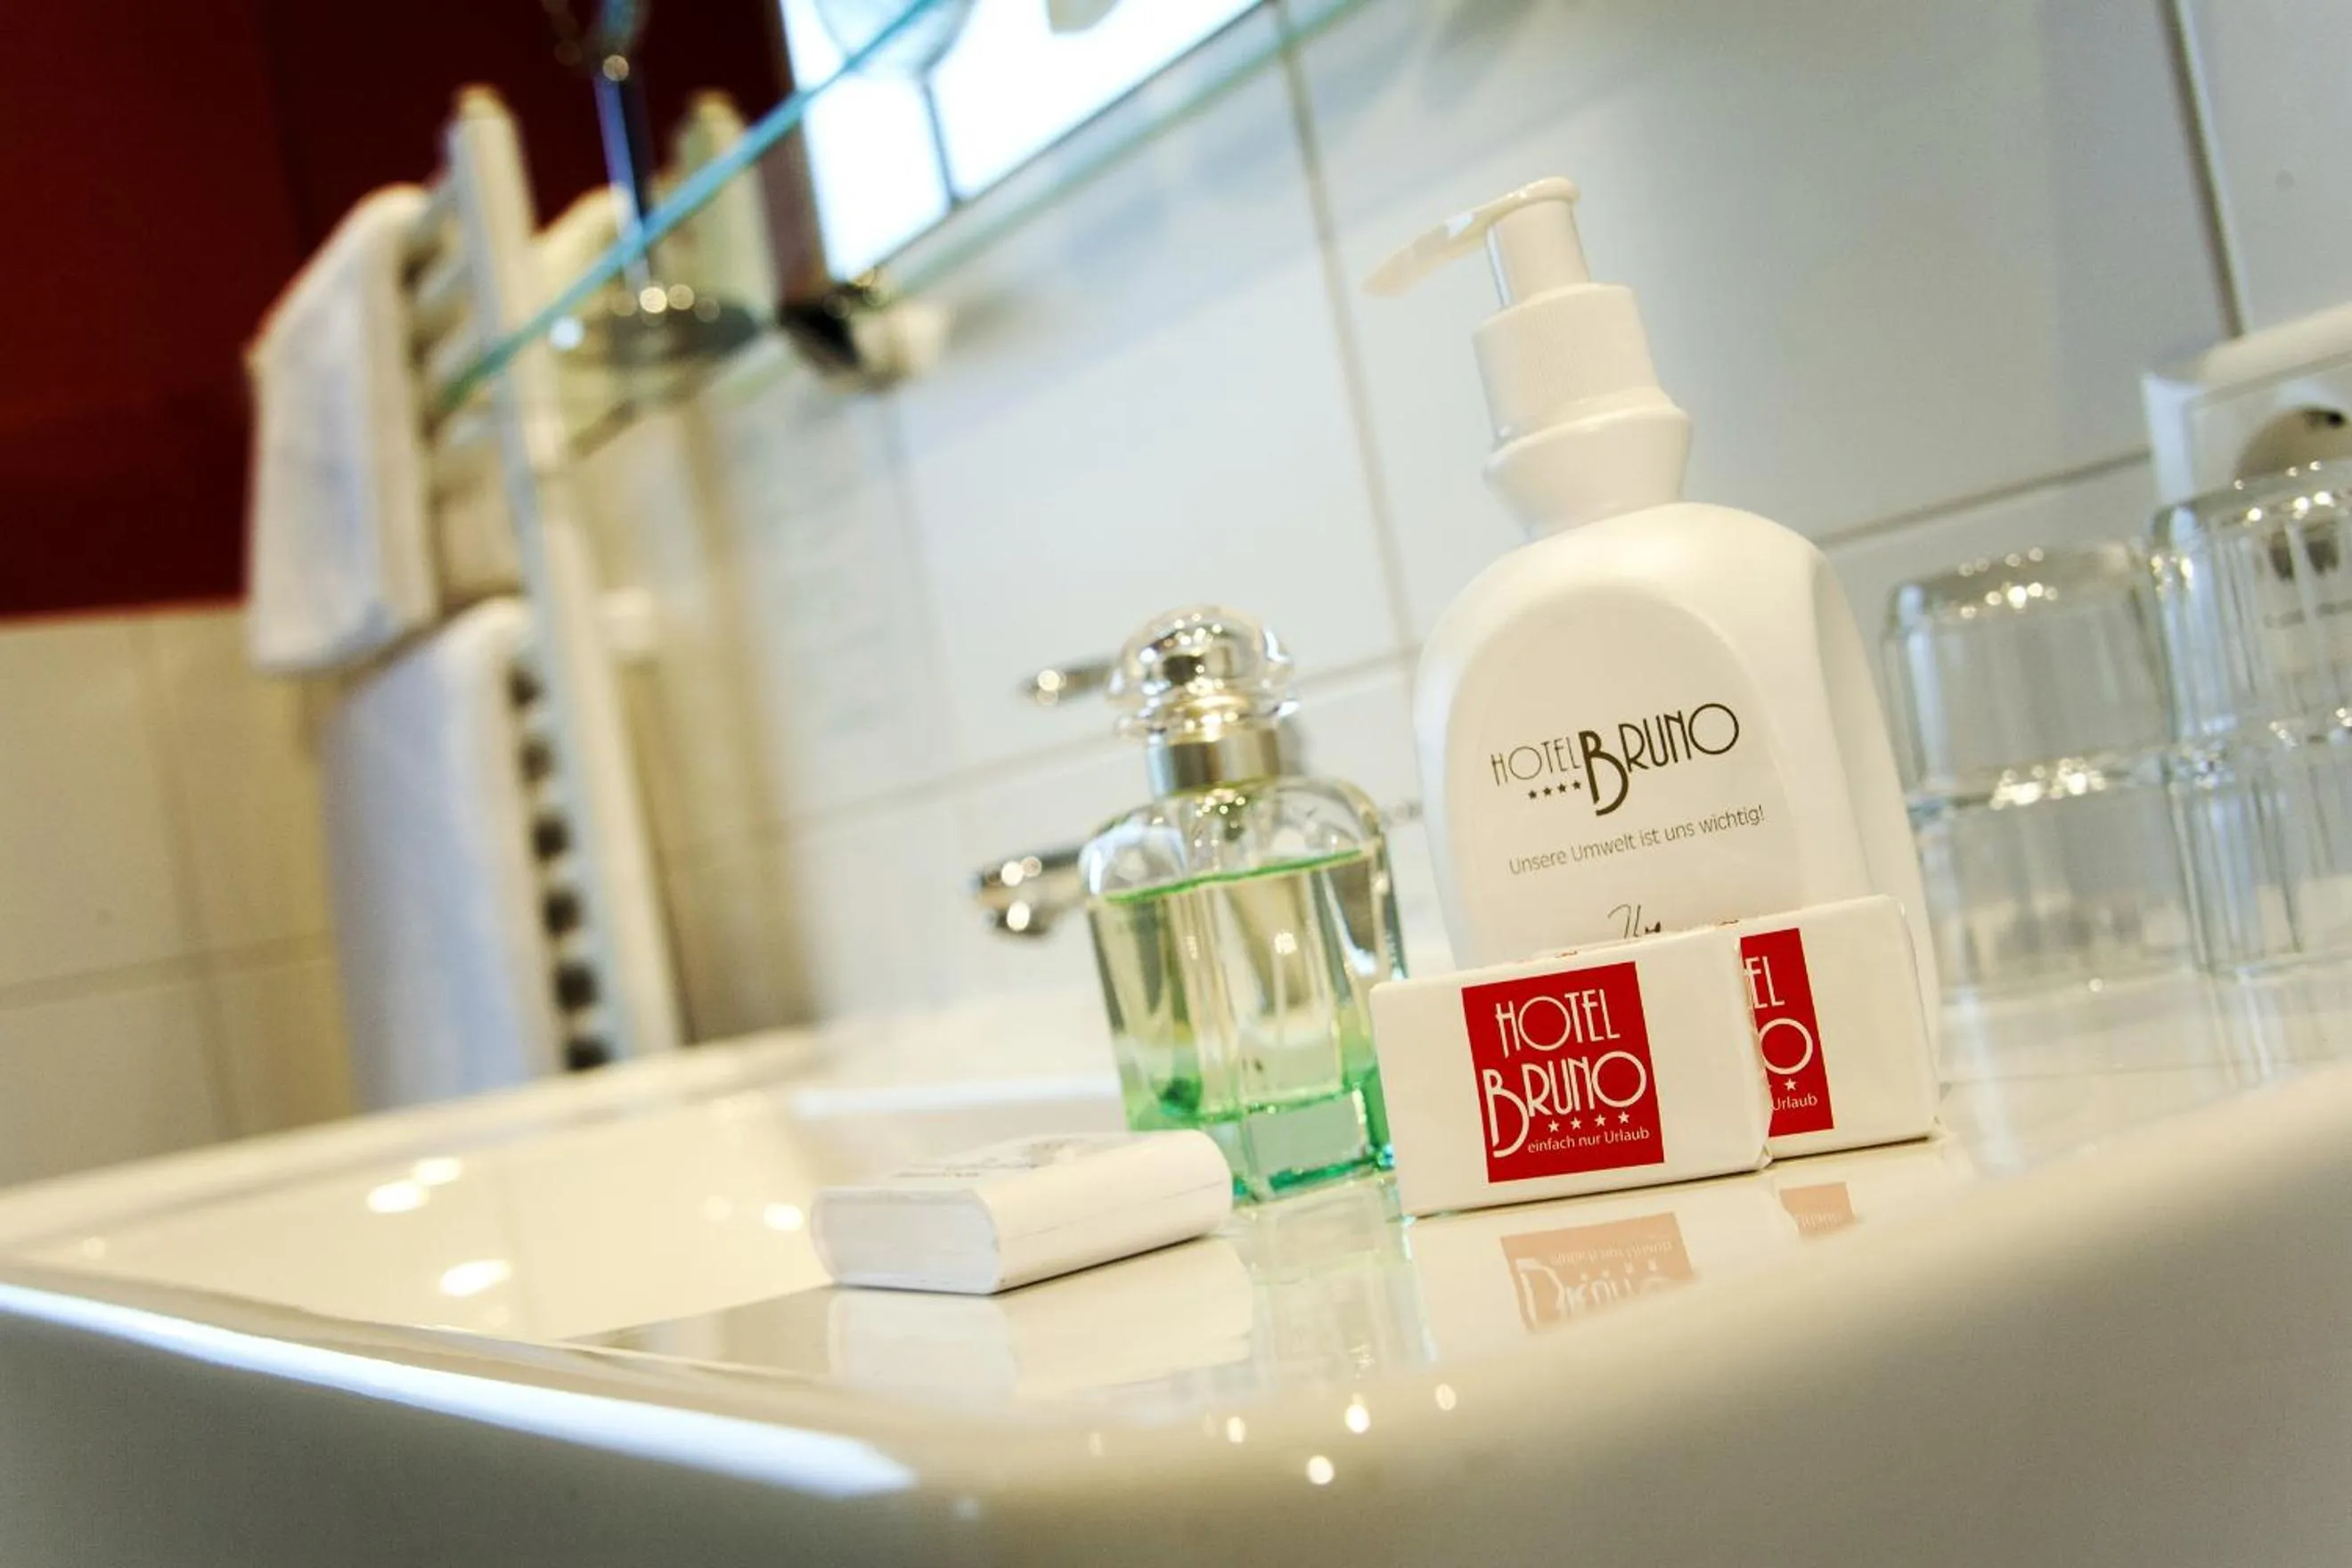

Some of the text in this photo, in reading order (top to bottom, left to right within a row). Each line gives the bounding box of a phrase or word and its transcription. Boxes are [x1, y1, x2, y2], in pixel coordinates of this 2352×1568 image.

[1490, 702, 1740, 817] HOTEL BRUNO
[1508, 804, 1766, 876] Unsere Umwelt ist uns wichtig!
[1494, 988, 1621, 1058] HOTEL
[1482, 1049, 1648, 1158] BRUNO
[1527, 1126, 1651, 1155] einfach nur Urlaub
